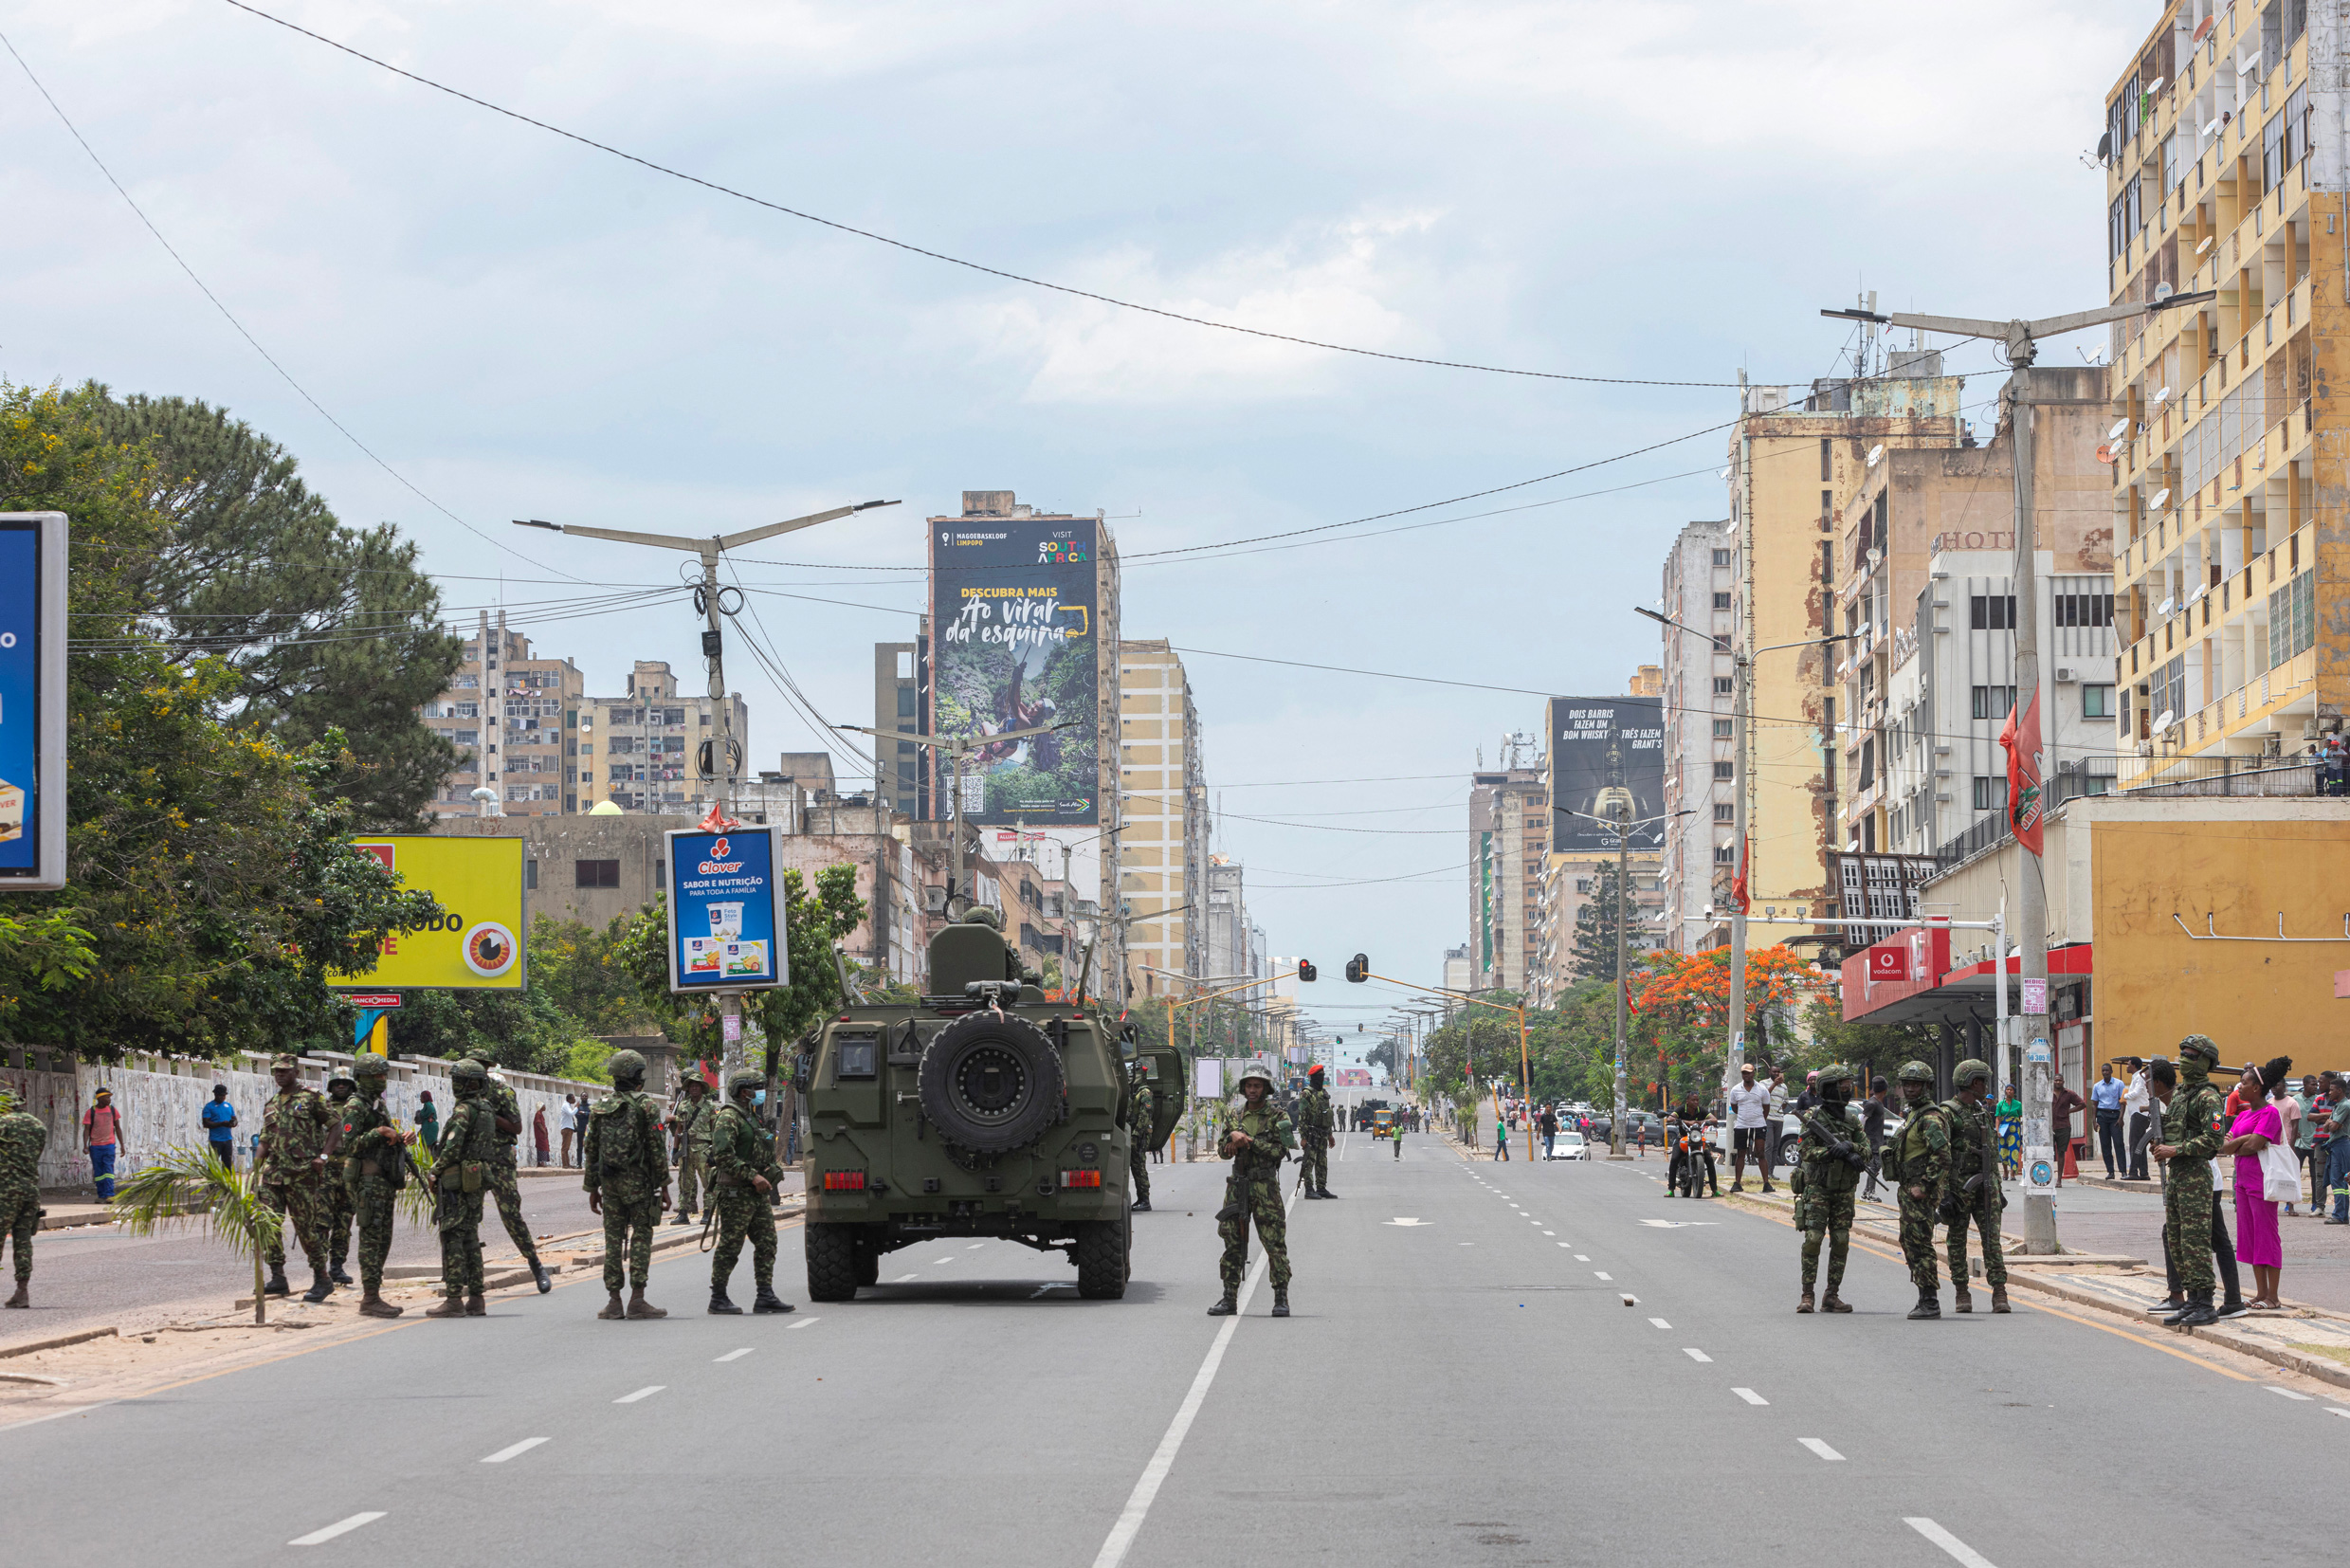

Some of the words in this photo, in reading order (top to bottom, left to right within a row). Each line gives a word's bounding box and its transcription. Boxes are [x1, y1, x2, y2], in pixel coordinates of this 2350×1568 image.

[1940, 531, 2042, 550] HOT
[1038, 541, 1086, 552] SOUTH
[1038, 552, 1087, 563] AFRICA
[960, 588, 1025, 597] DESCUBRA
[1028, 587, 1058, 597] MAIS
[960, 593, 992, 633] Ao
[1002, 597, 1060, 624] virar
[945, 617, 971, 644] da
[981, 619, 1065, 652] esquina
[1569, 709, 1586, 719] DOIS
[1587, 709, 1613, 719] BARRIS
[1574, 720, 1594, 729] FAZEM
[1596, 720, 1608, 729] UM
[1563, 730, 1579, 739] BOM
[1580, 729, 1609, 739] WHISKY
[1621, 728, 1638, 738] TRÊS
[1640, 729, 1661, 738] FAZEM
[699, 860, 742, 874] Clover
[683, 880, 710, 889] SABOR
[718, 876, 763, 887] NUTRIÇÃO
[398, 913, 463, 932] ODO
